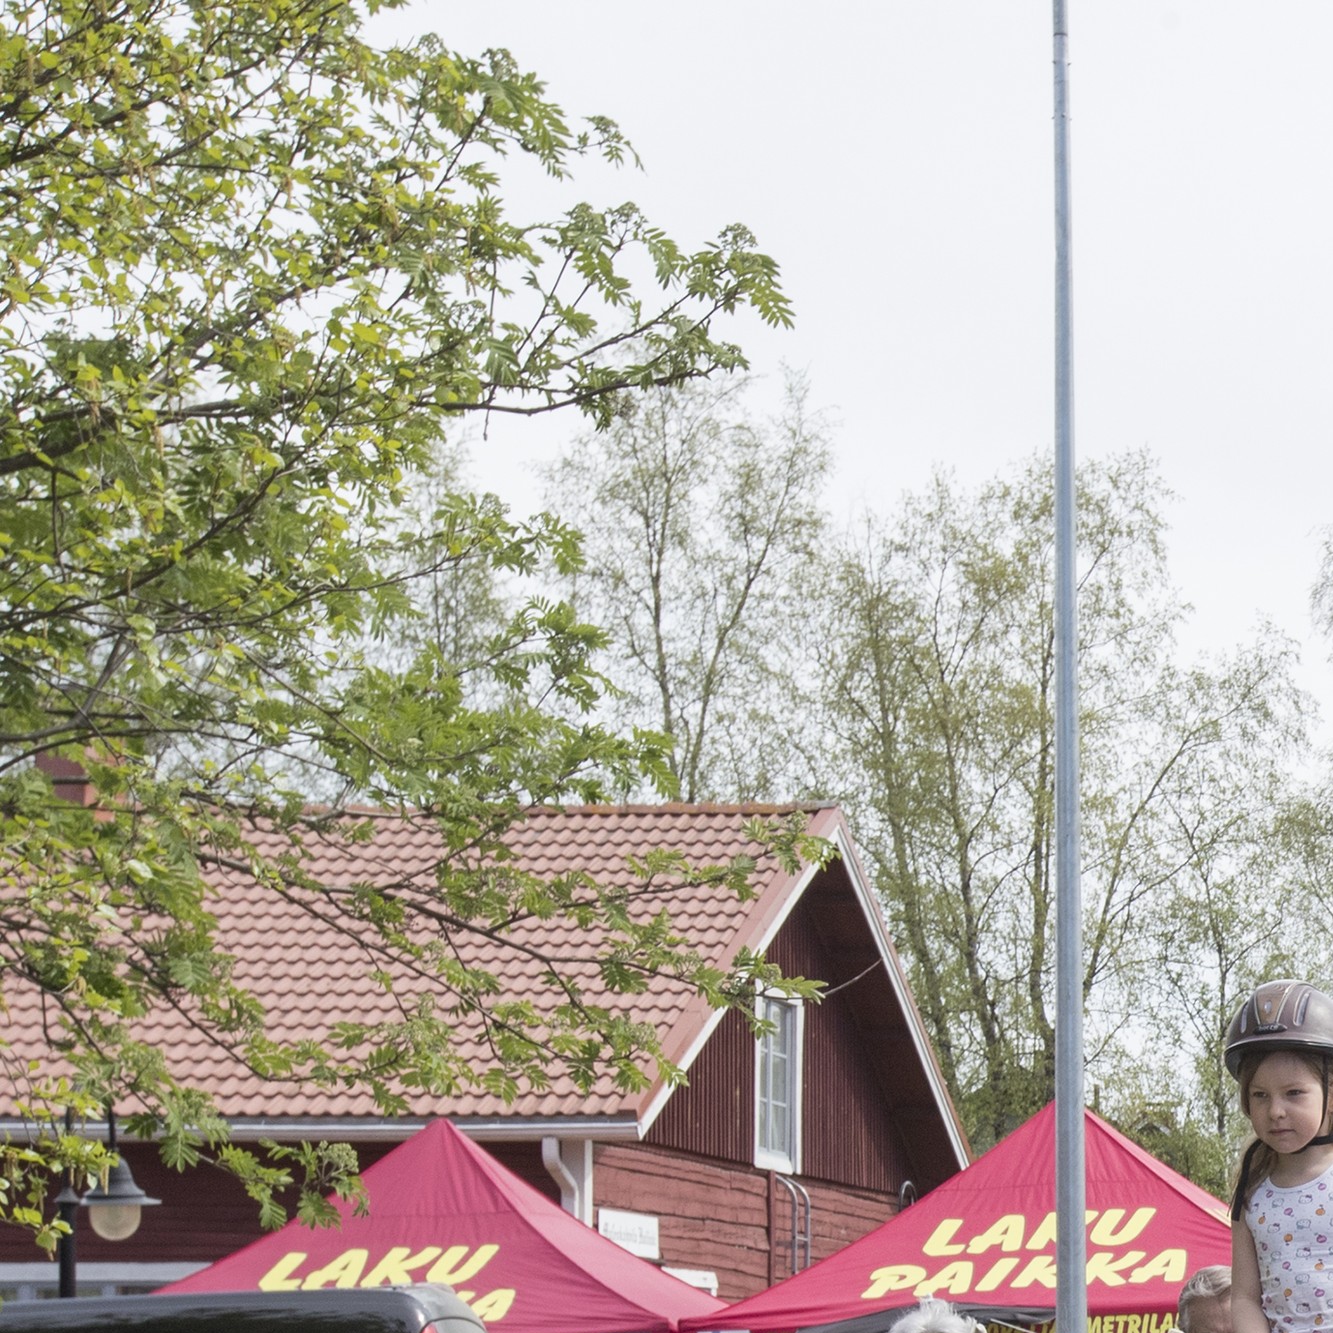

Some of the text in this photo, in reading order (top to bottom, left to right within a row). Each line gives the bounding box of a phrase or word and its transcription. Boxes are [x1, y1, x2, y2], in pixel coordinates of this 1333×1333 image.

[922, 1207, 1156, 1257] LAKU
[258, 1244, 500, 1291] LAKU
[861, 1249, 1187, 1299] PAIKKA
